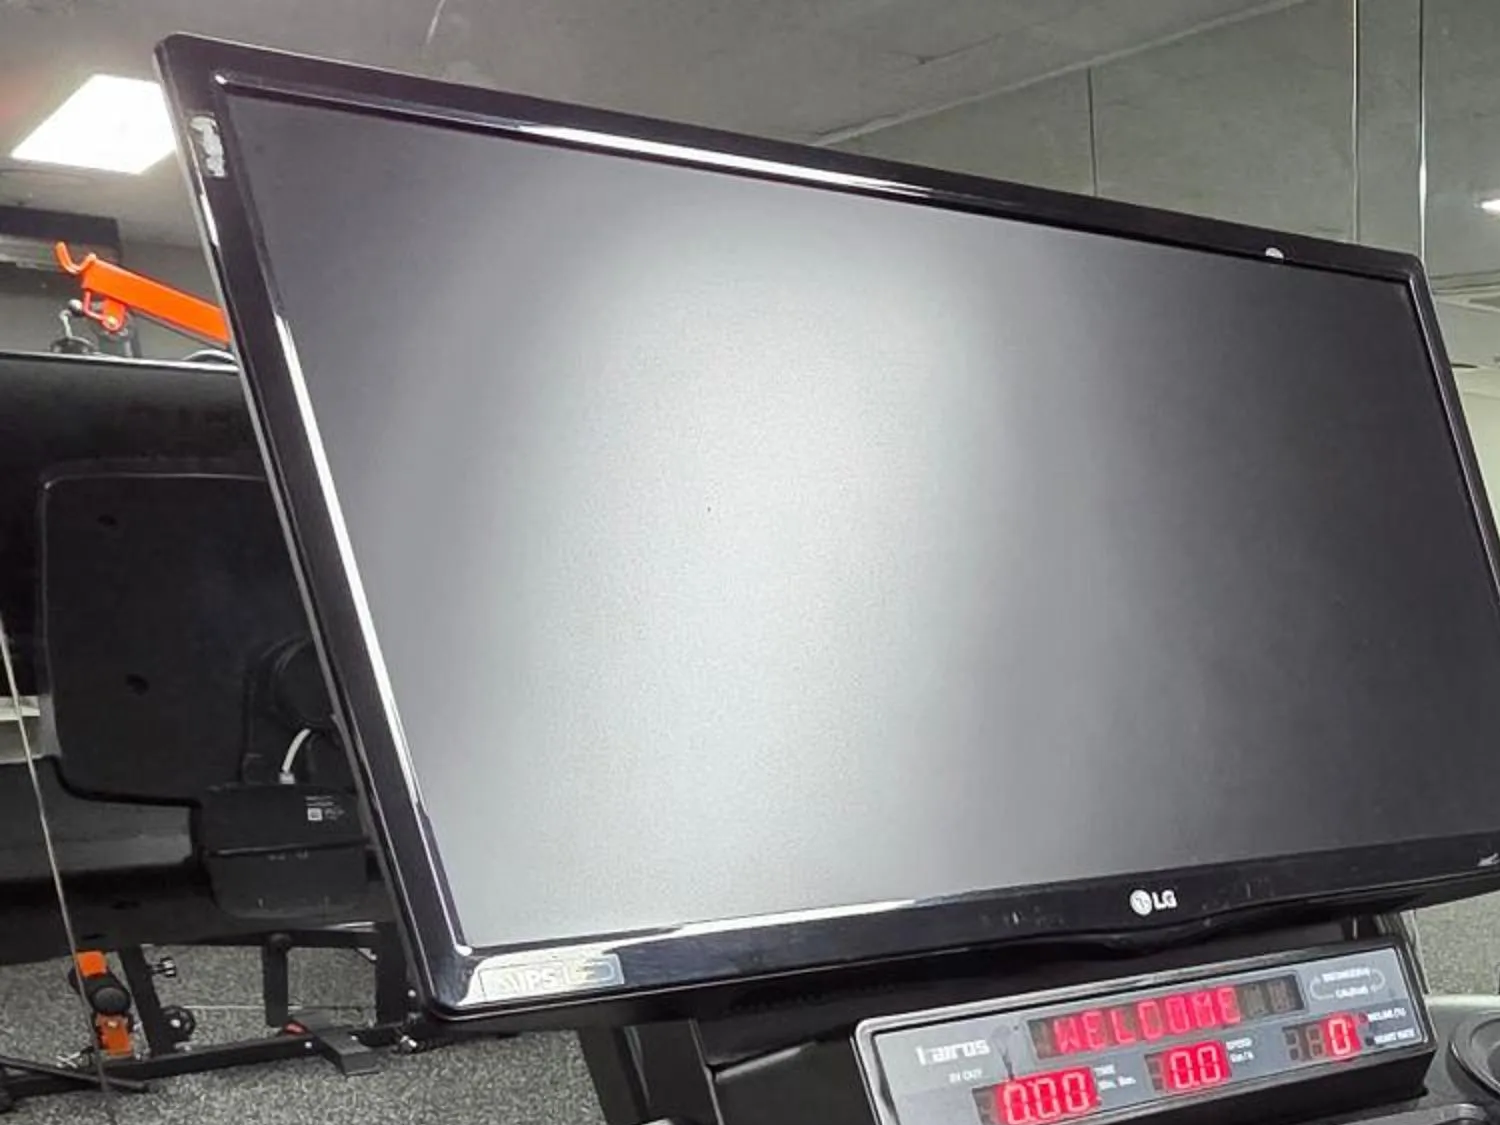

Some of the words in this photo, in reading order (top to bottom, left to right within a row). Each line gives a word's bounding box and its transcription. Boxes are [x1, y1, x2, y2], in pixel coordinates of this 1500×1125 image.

[1151, 889, 1178, 911] LG
[1053, 987, 1241, 1054] WELCOME
[1327, 1018, 1351, 1056] 0
